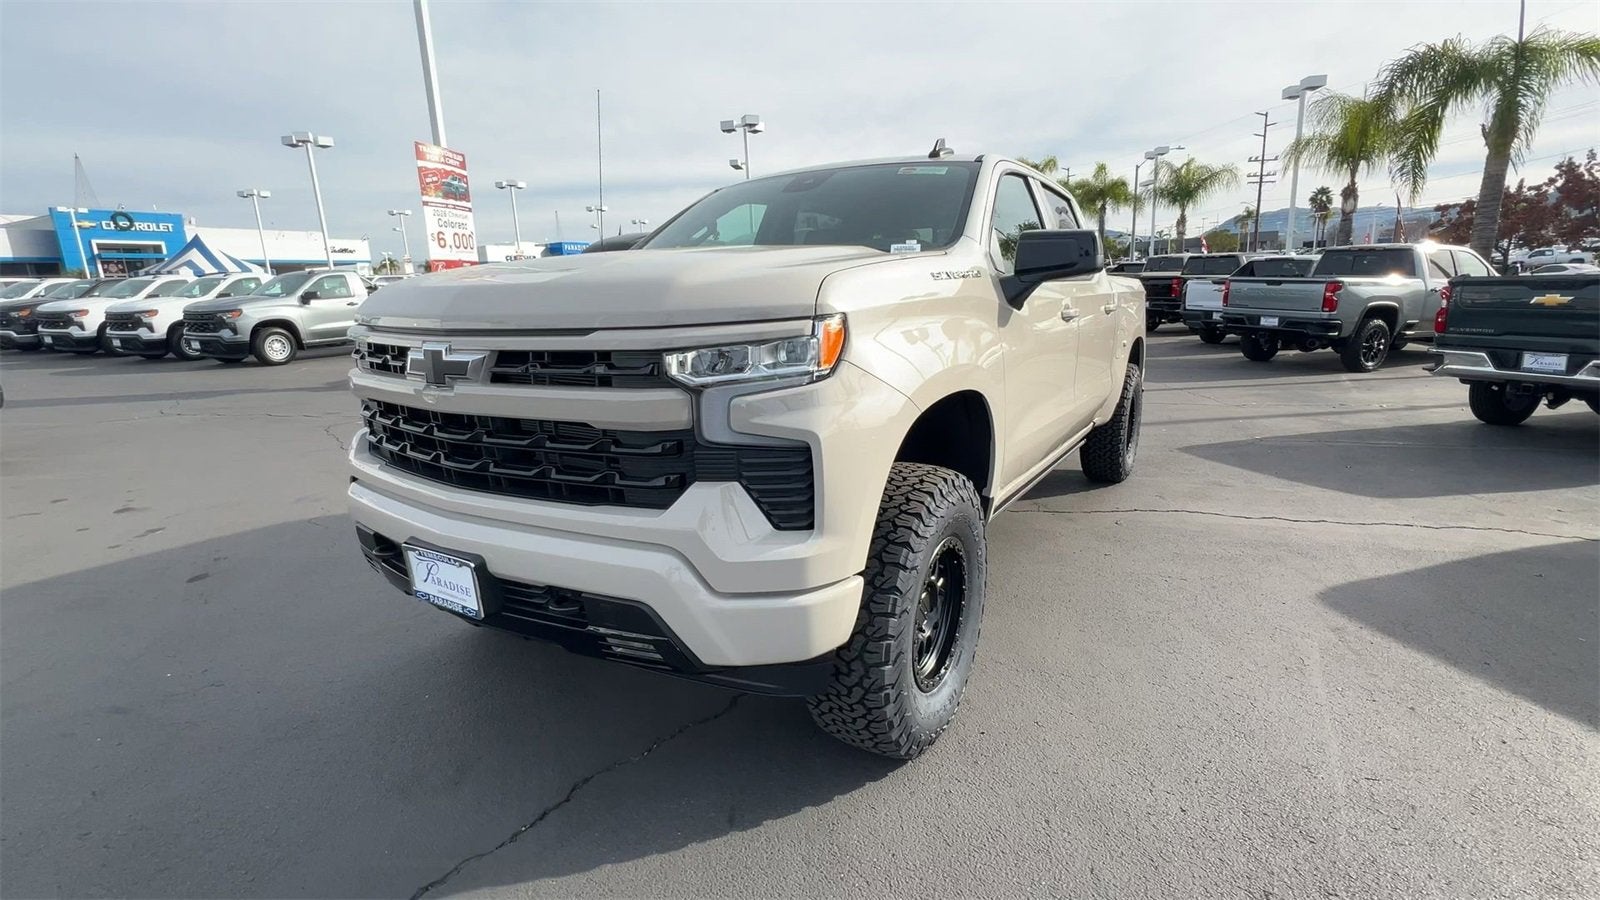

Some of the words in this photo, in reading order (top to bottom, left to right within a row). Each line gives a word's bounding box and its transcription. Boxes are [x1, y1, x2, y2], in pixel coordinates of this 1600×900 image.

[101, 220, 174, 232] CHROLET
[437, 217, 468, 230] Colorado
[420, 551, 455, 563] TEMECULA
[414, 556, 472, 598] PARADISE
[429, 595, 463, 612] PARADISE
